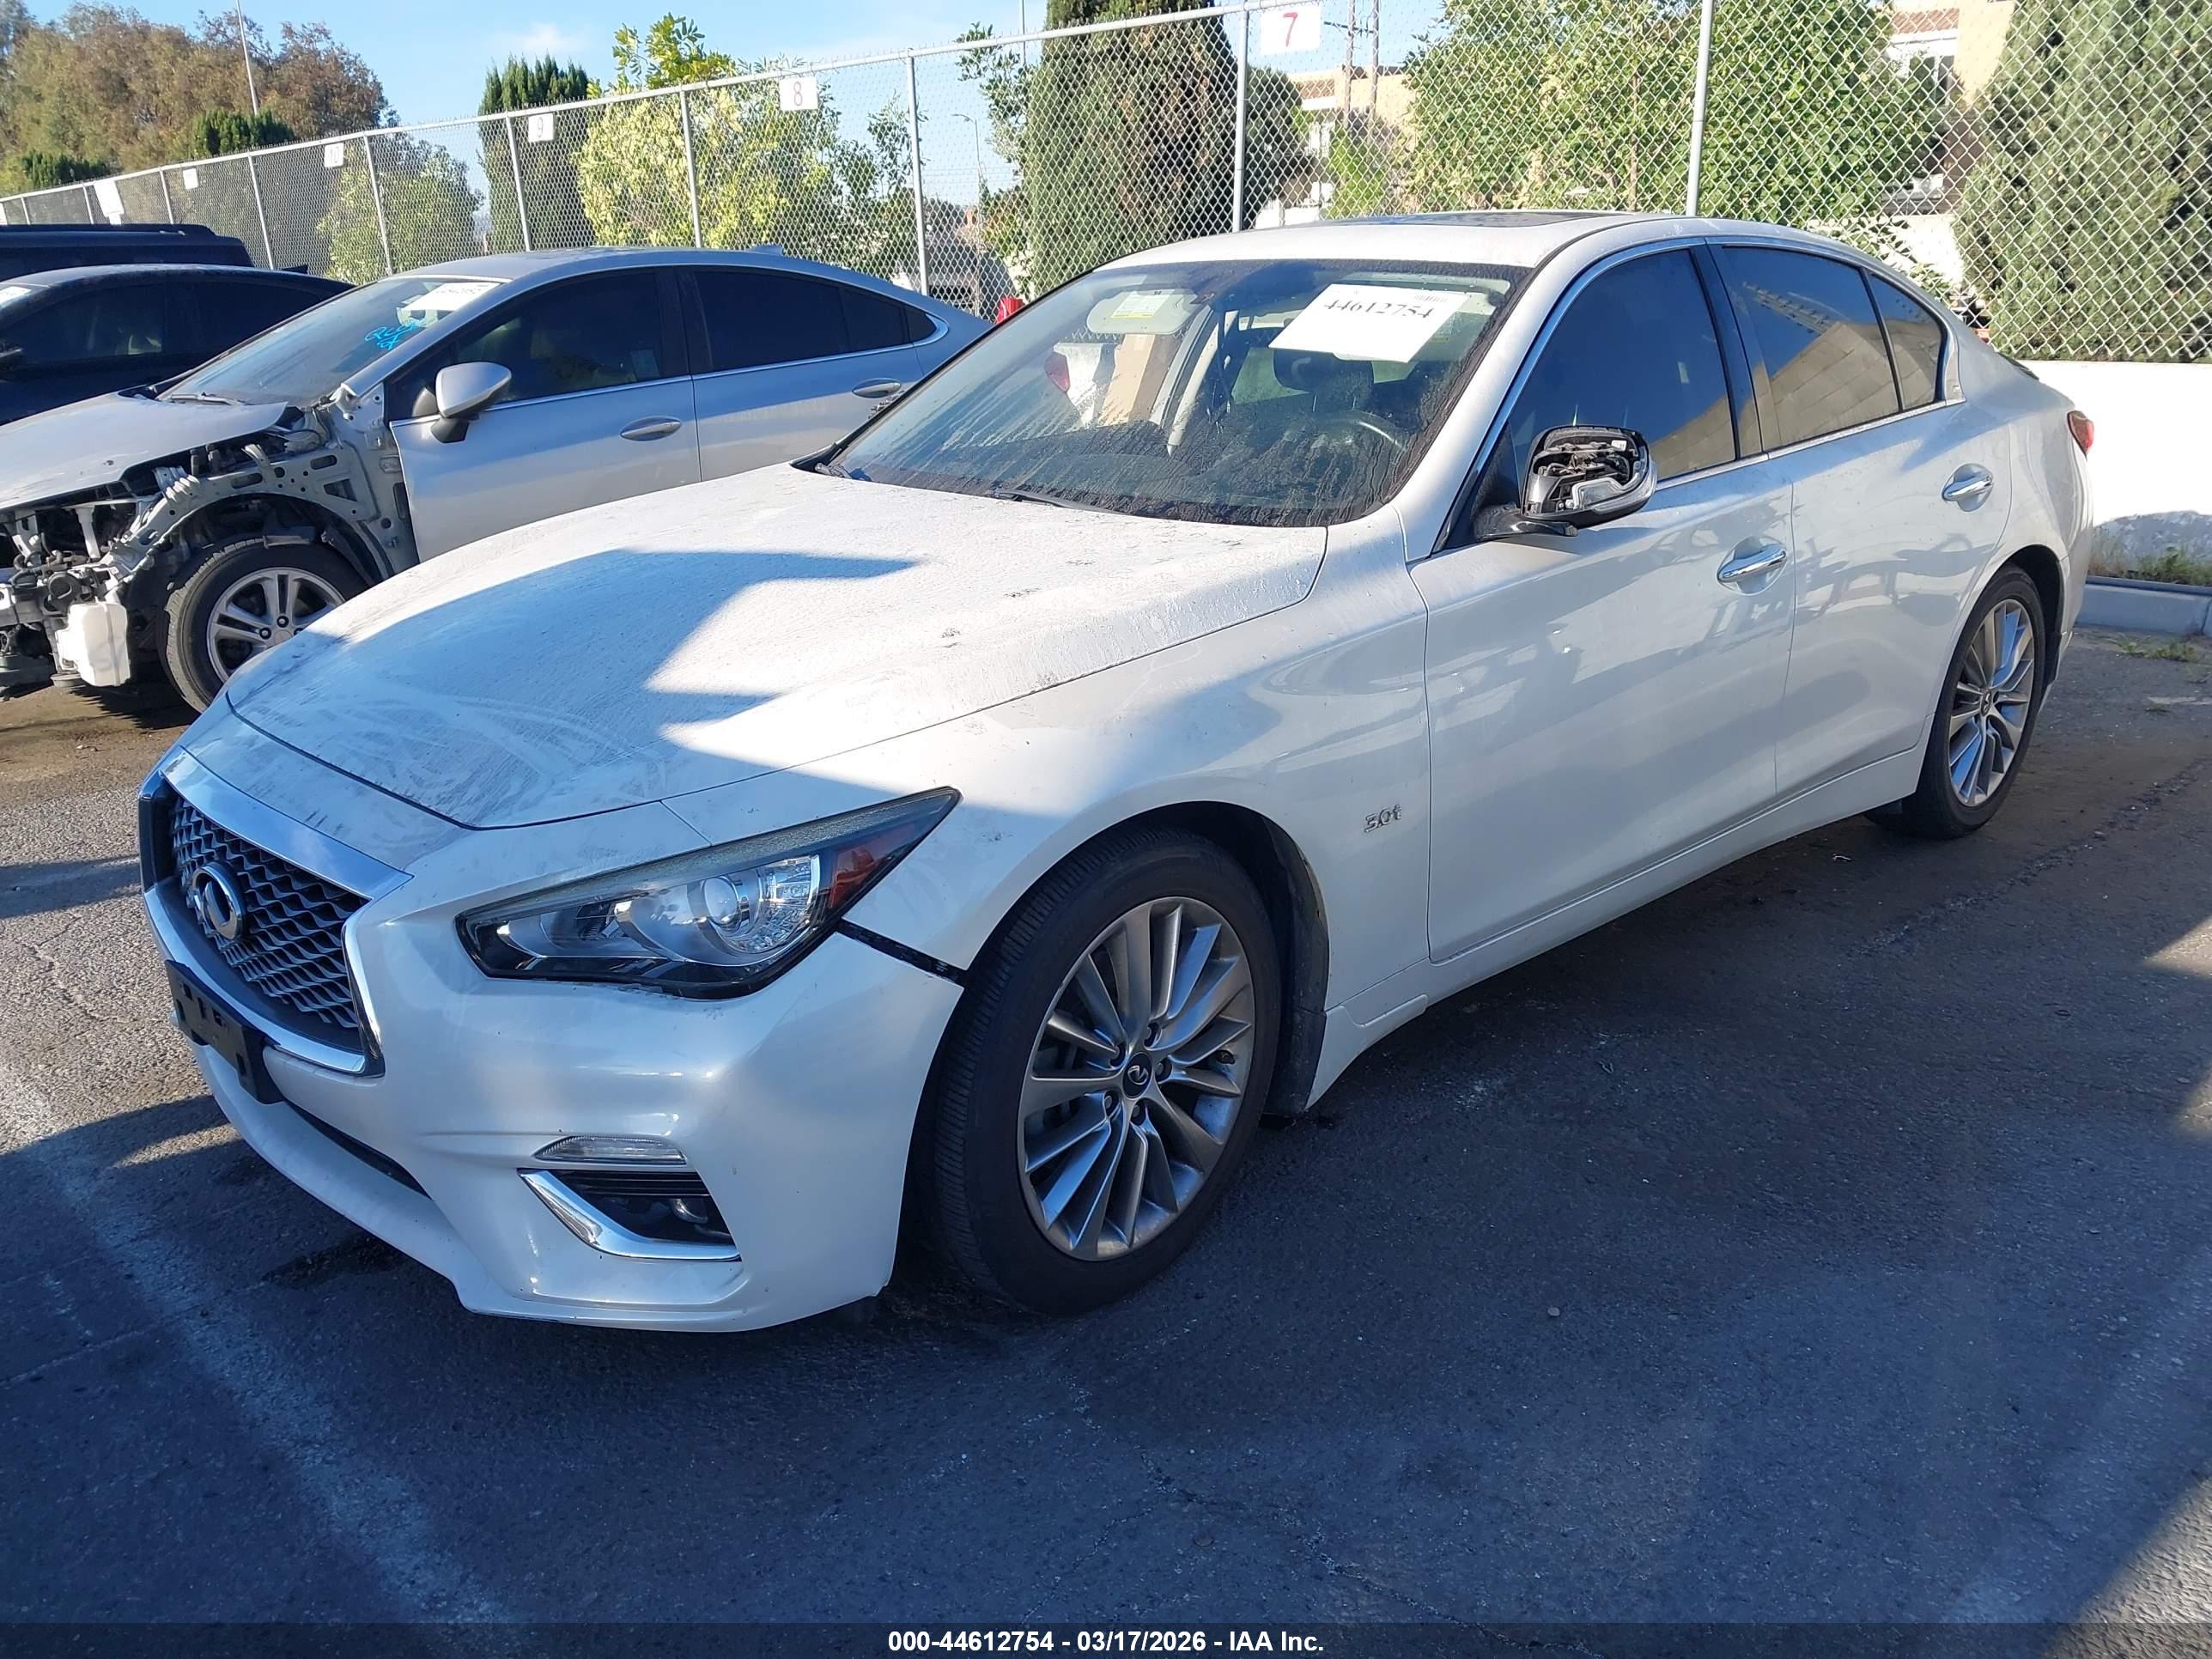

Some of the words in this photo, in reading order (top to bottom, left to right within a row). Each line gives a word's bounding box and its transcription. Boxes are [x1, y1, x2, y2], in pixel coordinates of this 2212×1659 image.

[1283, 12, 1298, 46] 7
[793, 81, 803, 106] 8
[1323, 299, 1435, 319] 44612754
